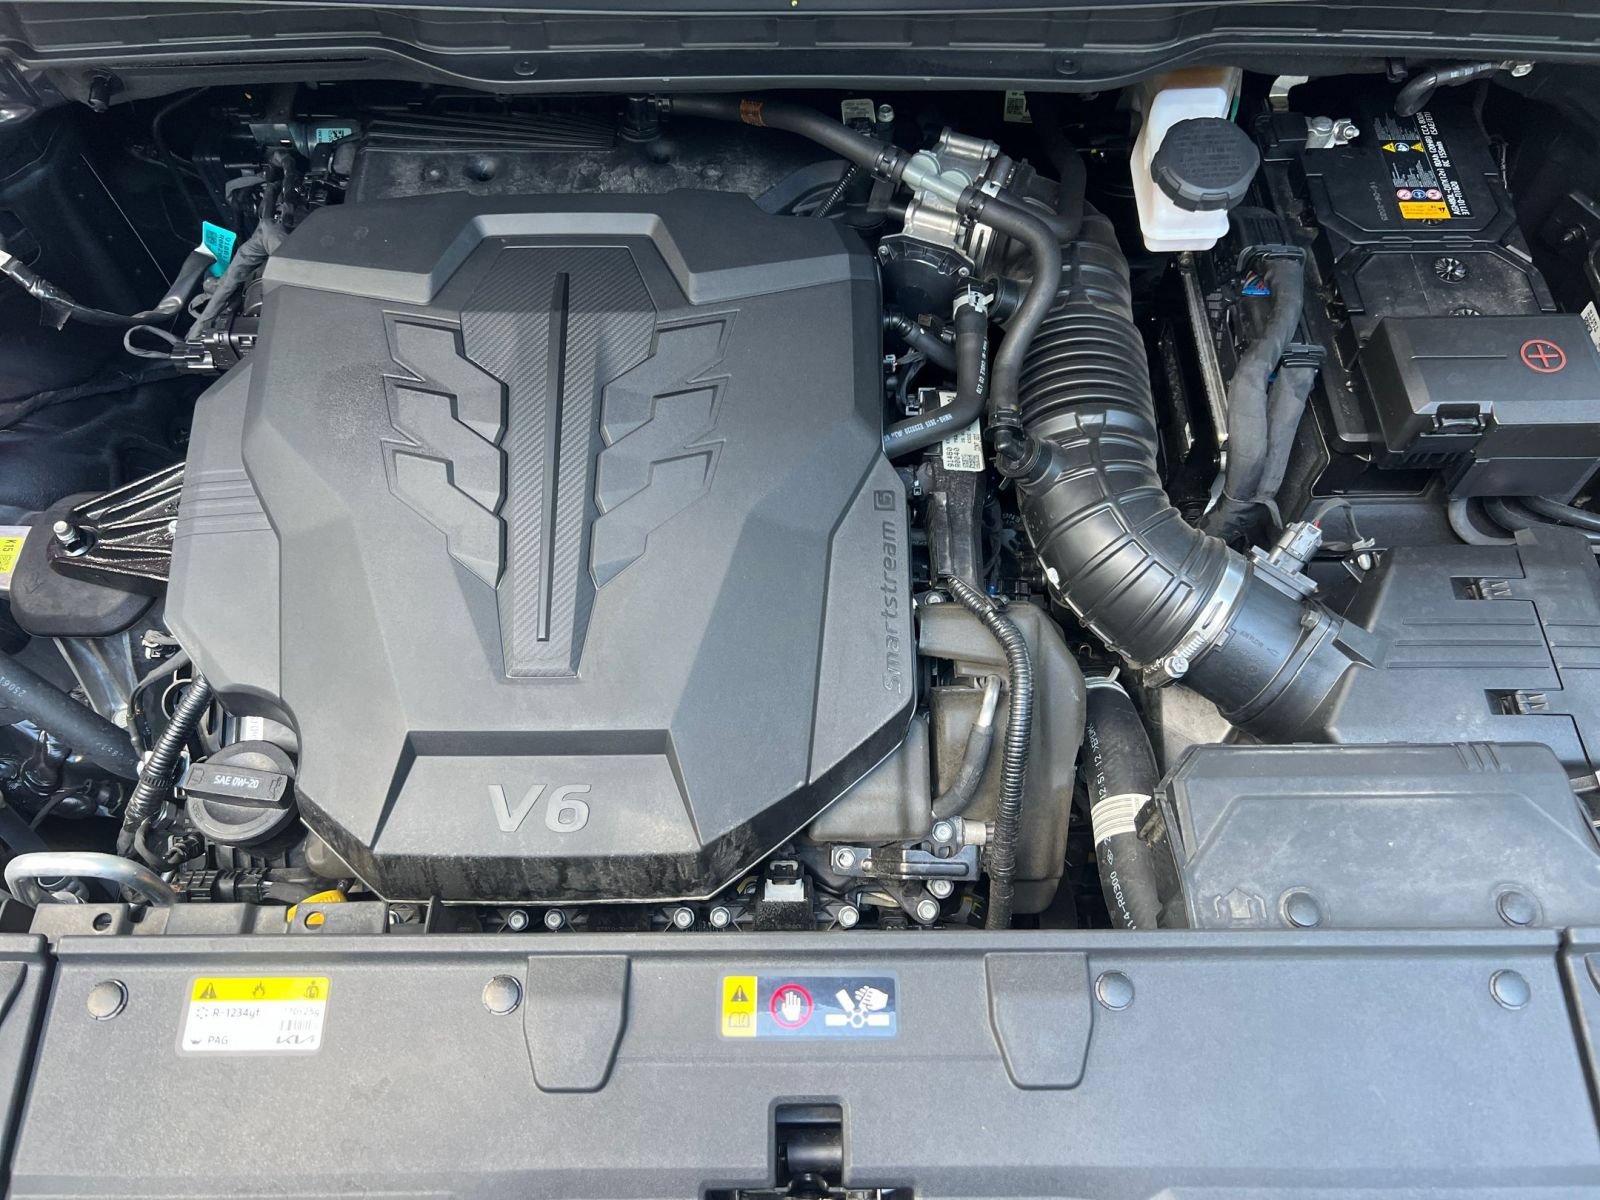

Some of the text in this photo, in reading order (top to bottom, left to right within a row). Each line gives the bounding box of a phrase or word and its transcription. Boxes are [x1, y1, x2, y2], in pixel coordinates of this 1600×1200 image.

[1421, 125, 1430, 136] CCA
[2, 539, 17, 552] K15
[881, 520, 902, 693] Smartstream
[213, 775, 259, 788] SAE 0W-20
[487, 783, 592, 833] V6
[213, 1007, 260, 1019] R-1234yf
[207, 1035, 228, 1045] PAG
